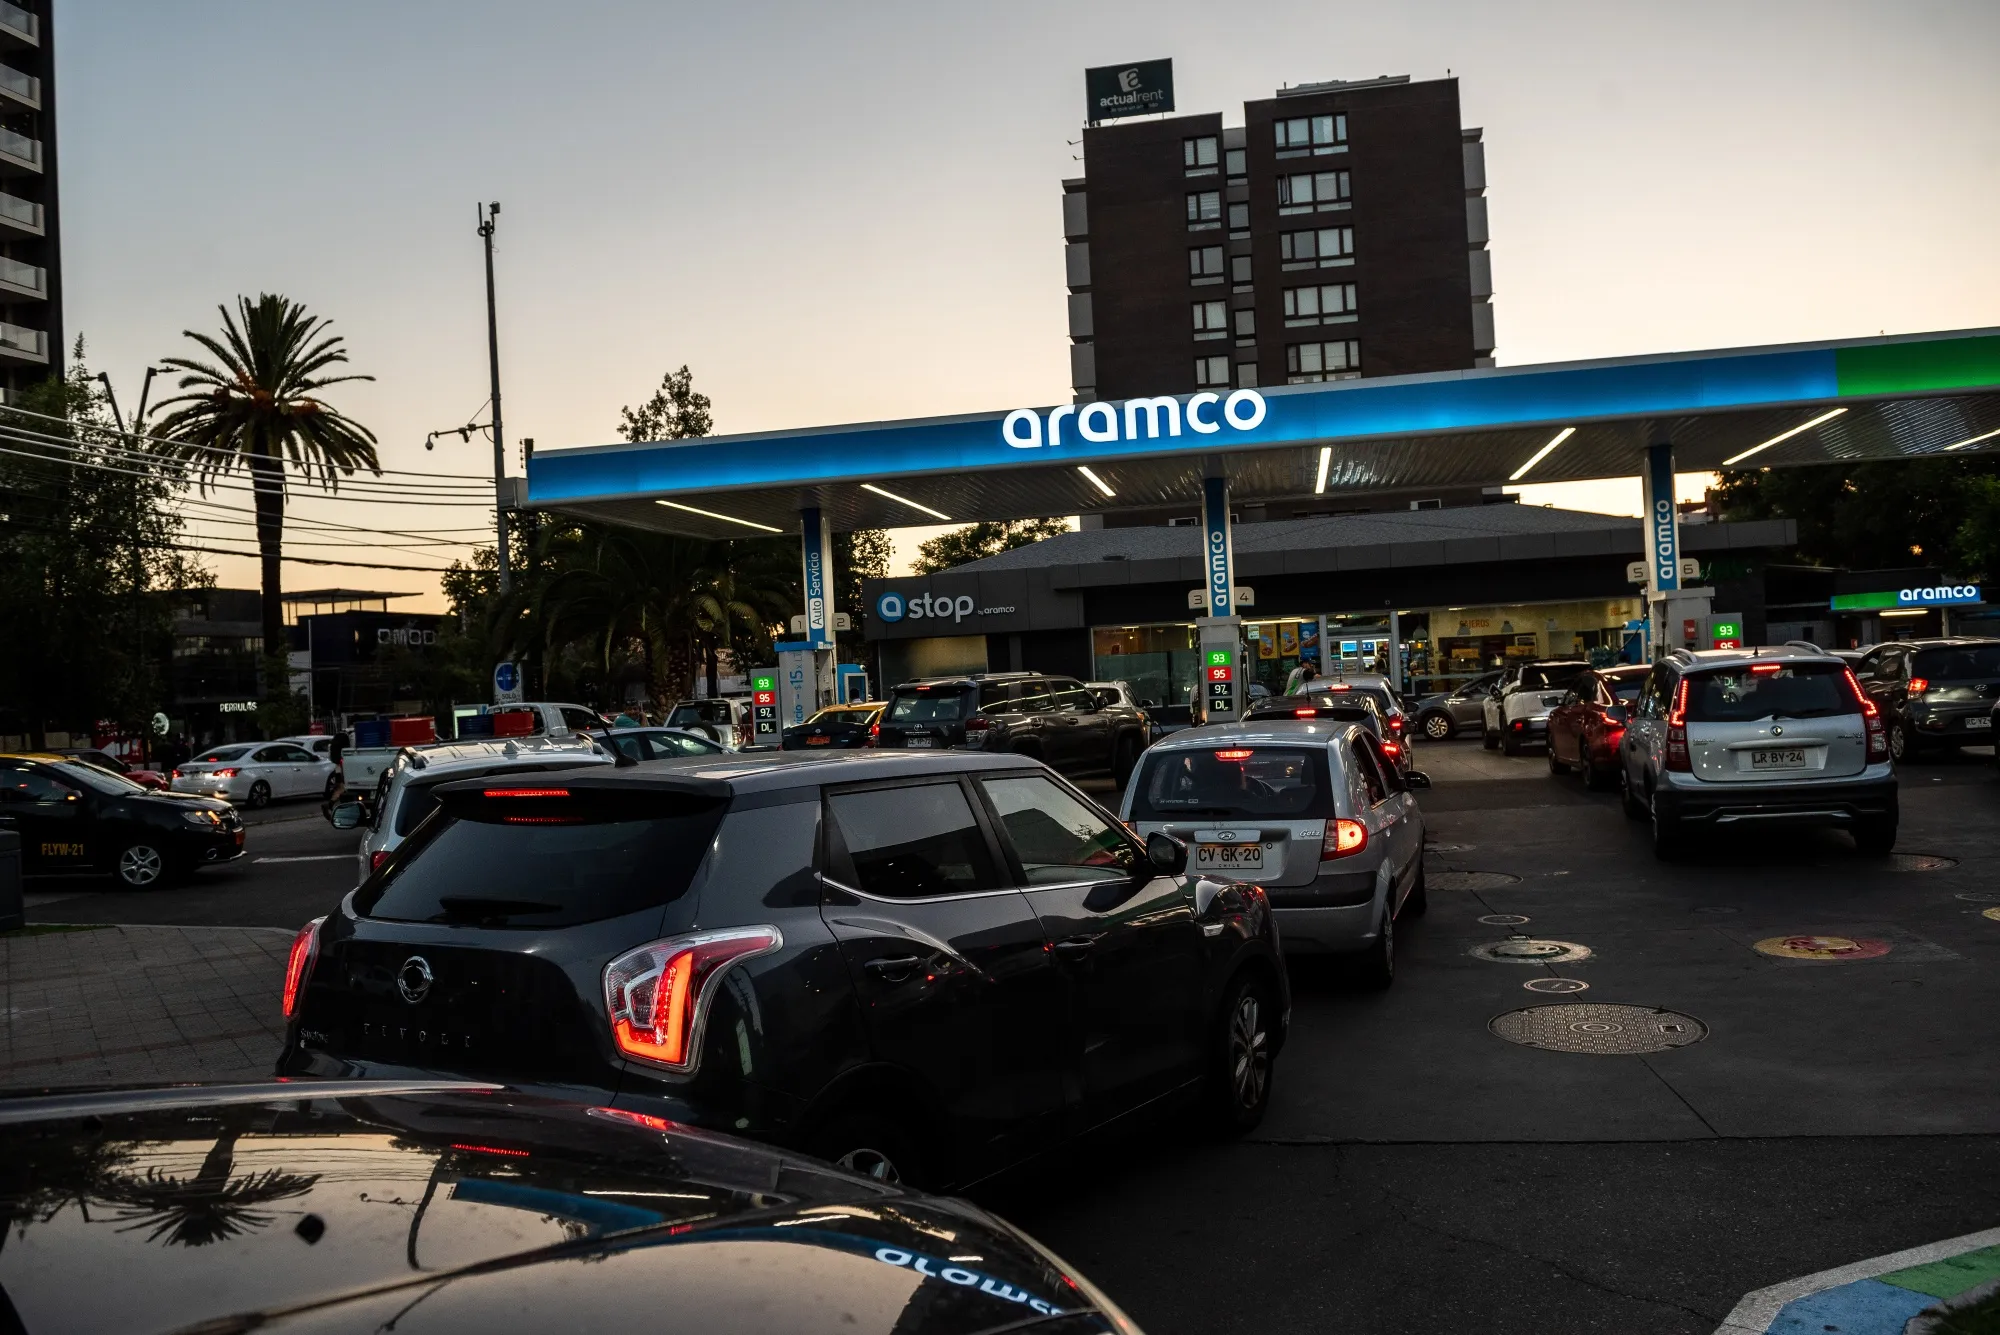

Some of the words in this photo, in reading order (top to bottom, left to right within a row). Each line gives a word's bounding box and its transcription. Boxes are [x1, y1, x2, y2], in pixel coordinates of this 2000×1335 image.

[1100, 89, 1164, 107] actualrent
[1002, 389, 1267, 448] aramco
[1657, 499, 1674, 580] aramco
[809, 552, 821, 596] Servicio
[1211, 530, 1227, 607] aramco
[1633, 567, 1643, 578] 5
[1684, 564, 1694, 575] 6
[1239, 592, 1249, 602] 4
[1900, 585, 1976, 601] aramco
[1193, 594, 1203, 605] 3
[811, 600, 823, 625] Auto
[908, 592, 974, 624] stop
[984, 606, 1015, 615] aramco
[836, 617, 845, 628] 2
[1719, 625, 1733, 636] 93
[1212, 653, 1226, 663] 93
[1213, 668, 1226, 679] 95
[758, 678, 770, 688] 93
[1214, 684, 1226, 694] 97
[759, 693, 770, 703] 95
[760, 707, 770, 717] 97
[41, 843, 84, 857] FLYW-21
